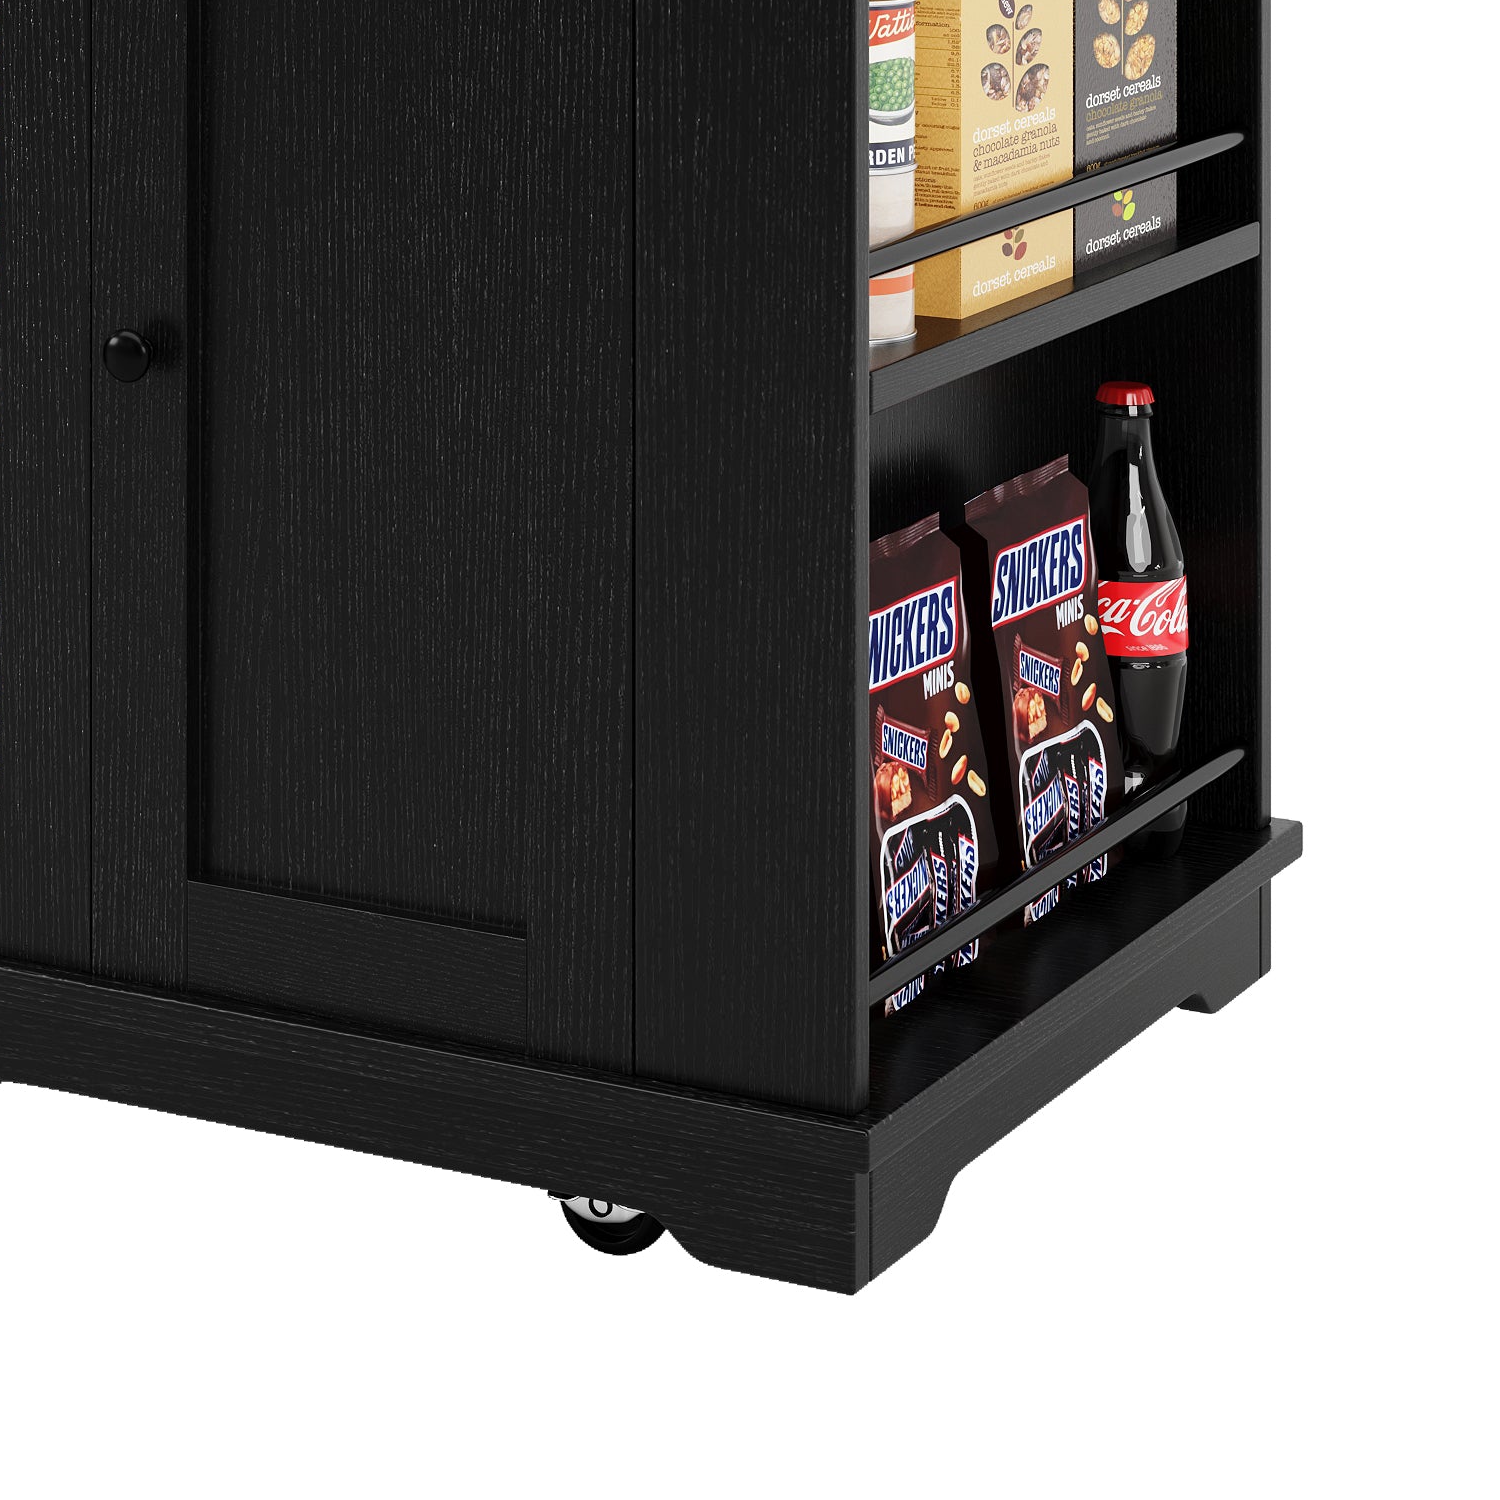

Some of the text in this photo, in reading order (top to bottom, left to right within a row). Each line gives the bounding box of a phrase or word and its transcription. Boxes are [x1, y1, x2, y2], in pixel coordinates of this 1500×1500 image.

[1086, 75, 1161, 109] dorset cereals
[1086, 89, 1164, 122] chocolate granola
[973, 107, 1056, 144] dorset cereals
[973, 122, 1057, 157] chocolate granola
[973, 136, 1060, 172] & macadamia nuts
[1085, 215, 1161, 255] dorset cereals
[972, 255, 1056, 297] dorset cereals
[992, 523, 1083, 623] SNICKERS
[1055, 594, 1084, 630] MINIS
[869, 586, 954, 685] NICKERS
[922, 660, 955, 700] MINIS
[1020, 653, 1060, 696] SNICKERS
[883, 724, 927, 769] SNICKERS
